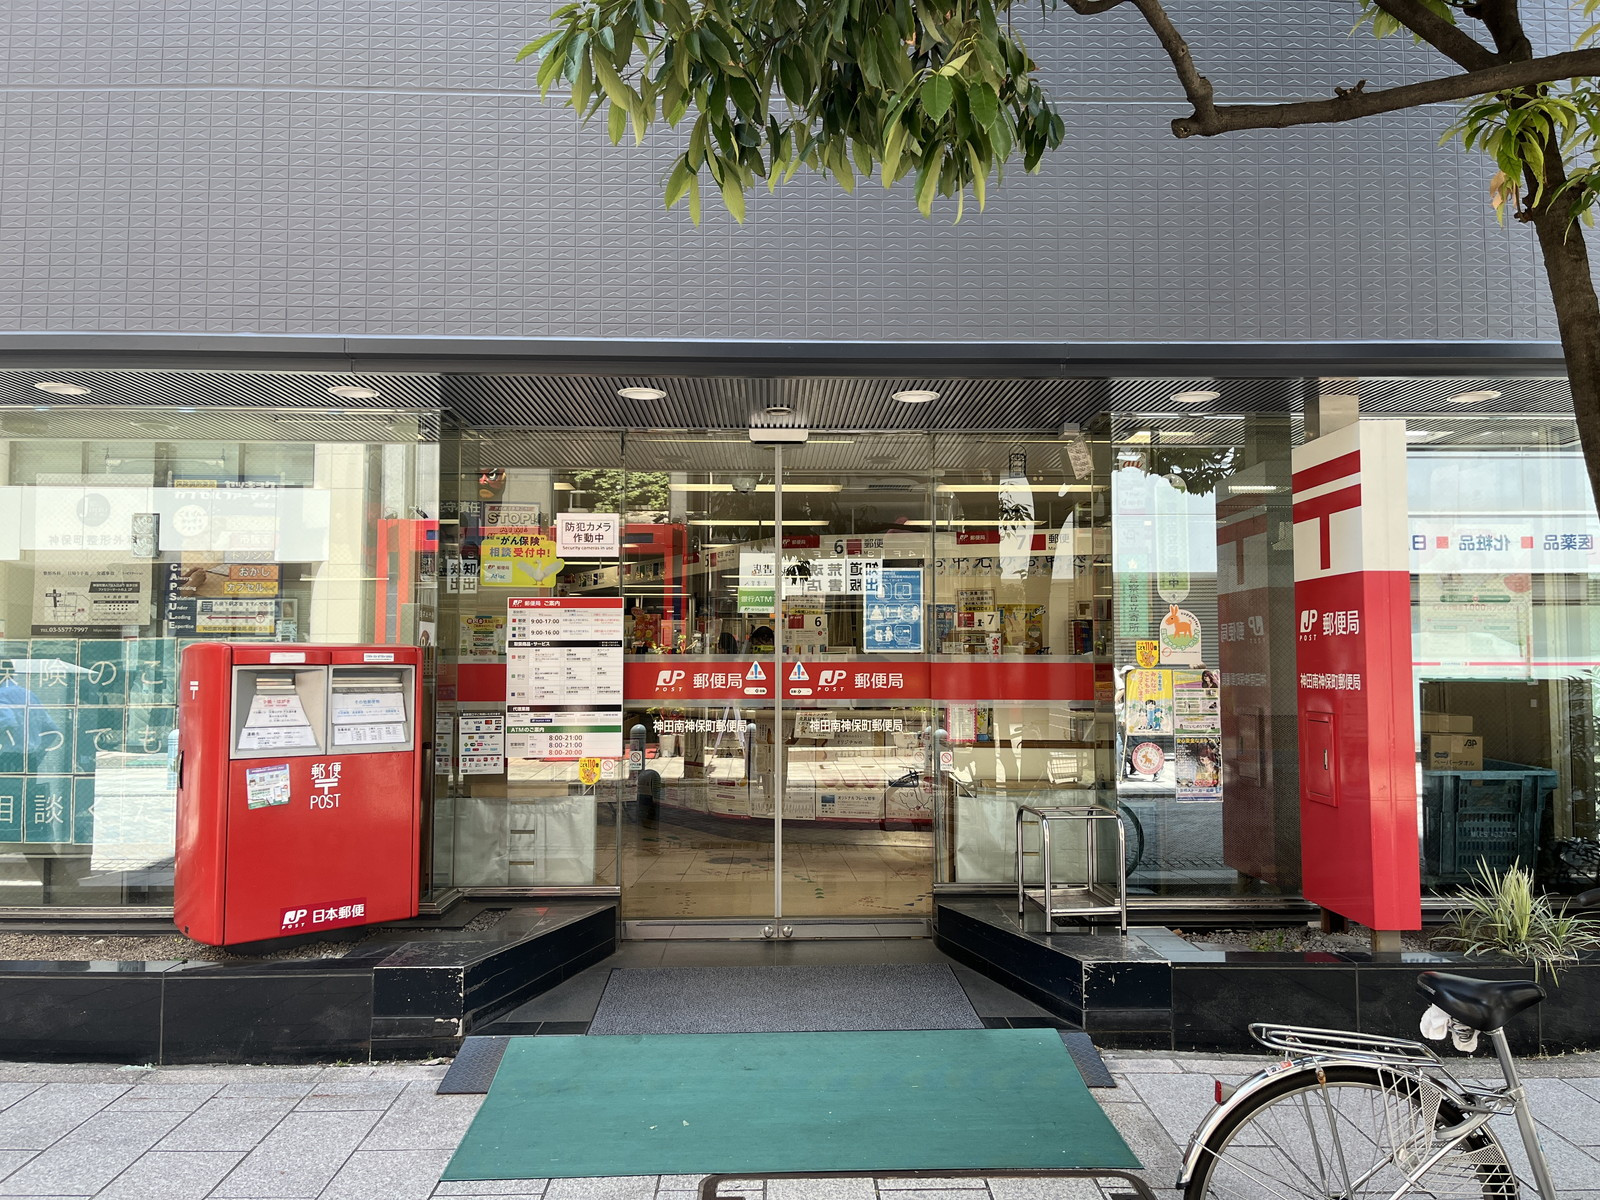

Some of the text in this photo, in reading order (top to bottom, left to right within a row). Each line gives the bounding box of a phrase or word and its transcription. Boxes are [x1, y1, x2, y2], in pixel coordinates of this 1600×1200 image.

[565, 522, 611, 532] 防犯カメラ
[573, 533, 604, 543] 作動中
[864, 538, 884, 548] 郵便
[1016, 535, 1027, 550] 7
[1048, 534, 1070, 543] 郵便
[489, 547, 550, 557] 相談受付中!
[834, 540, 844, 554] 6
[239, 567, 270, 577] おかし
[169, 583, 197, 591] Providing
[169, 593, 196, 601] Solutions
[741, 595, 772, 603] 銀行ATM
[169, 612, 191, 620] Leading
[815, 617, 822, 627] 6
[987, 614, 995, 625] 7
[1300, 609, 1318, 633] JP
[1322, 610, 1360, 636] 郵便局
[169, 621, 194, 629] Expertise
[656, 670, 686, 686] JP
[693, 673, 743, 689] 郵便局
[818, 670, 847, 686] JP
[854, 673, 904, 689] 郵便局
[1300, 673, 1361, 691] 神田南神保町郵便局
[652, 719, 747, 733] 神田南神保町郵便局
[809, 718, 903, 733] 神田南神保町郵便局
[310, 762, 342, 780] 郵便
[310, 794, 342, 810] POST
[282, 909, 308, 925] JP
[312, 903, 365, 924] 日本郵便
